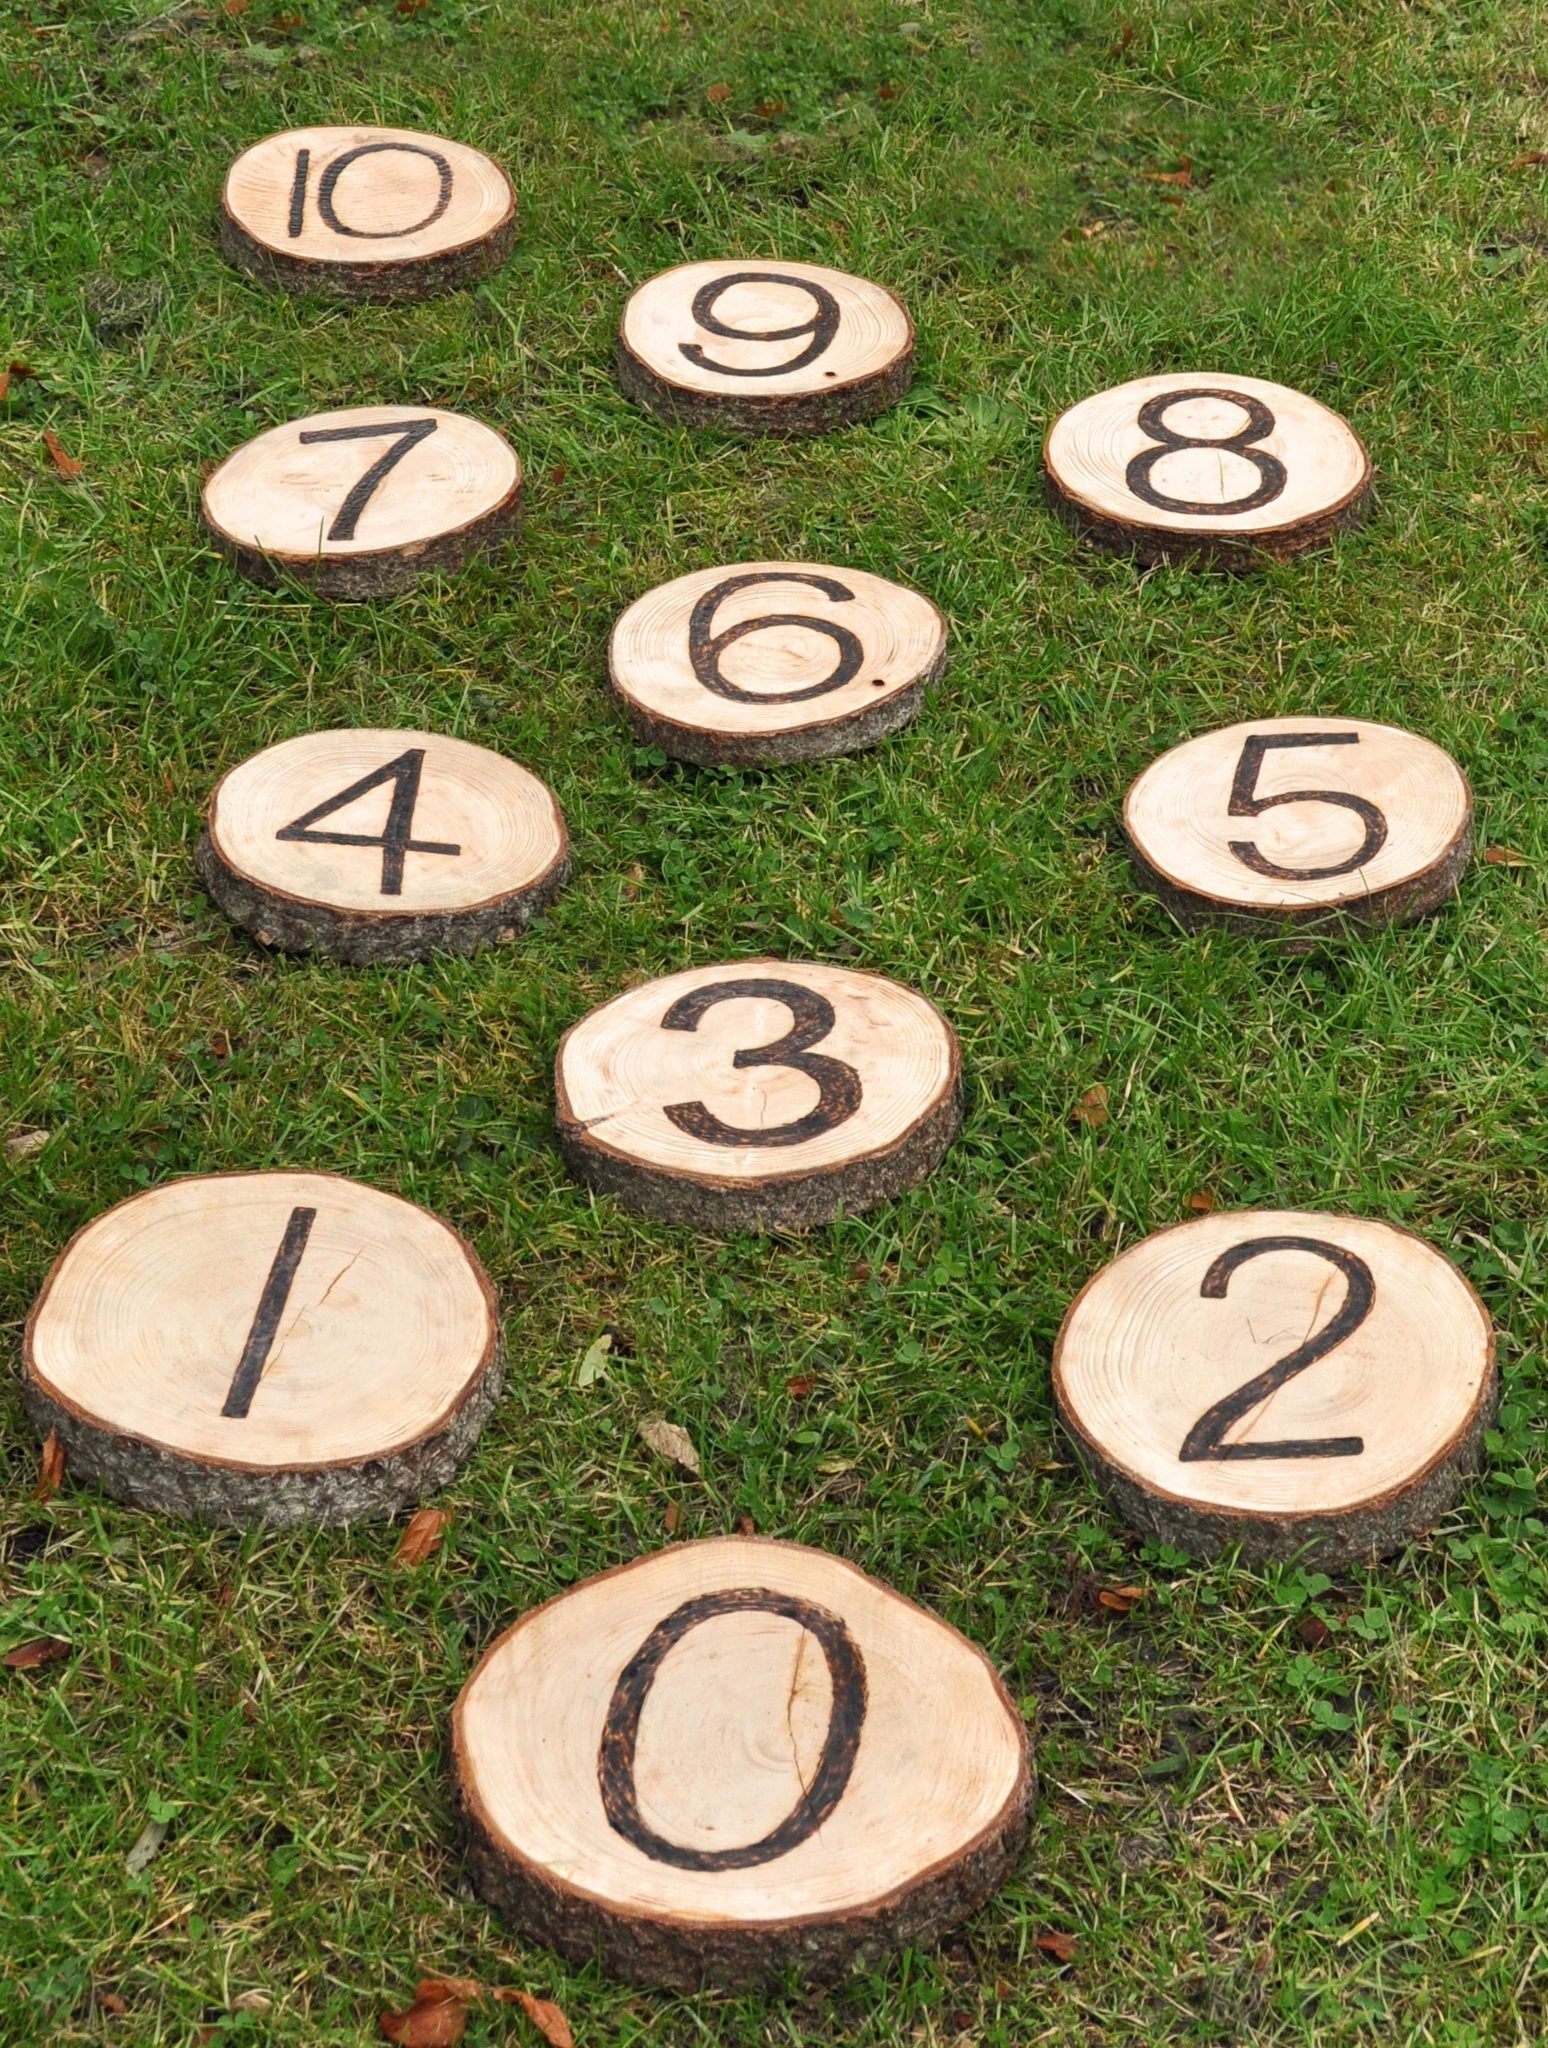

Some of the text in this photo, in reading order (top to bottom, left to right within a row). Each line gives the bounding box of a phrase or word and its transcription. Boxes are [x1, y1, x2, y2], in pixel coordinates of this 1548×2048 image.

[289, 142, 454, 239] 10
[299, 418, 438, 541] 7
[1126, 388, 1287, 516] 8
[275, 748, 461, 896] 4
[1227, 732, 1388, 881] 5
[660, 978, 863, 1148] 3
[1178, 1236, 1376, 1463] 2
[597, 1587, 867, 1873] 0
